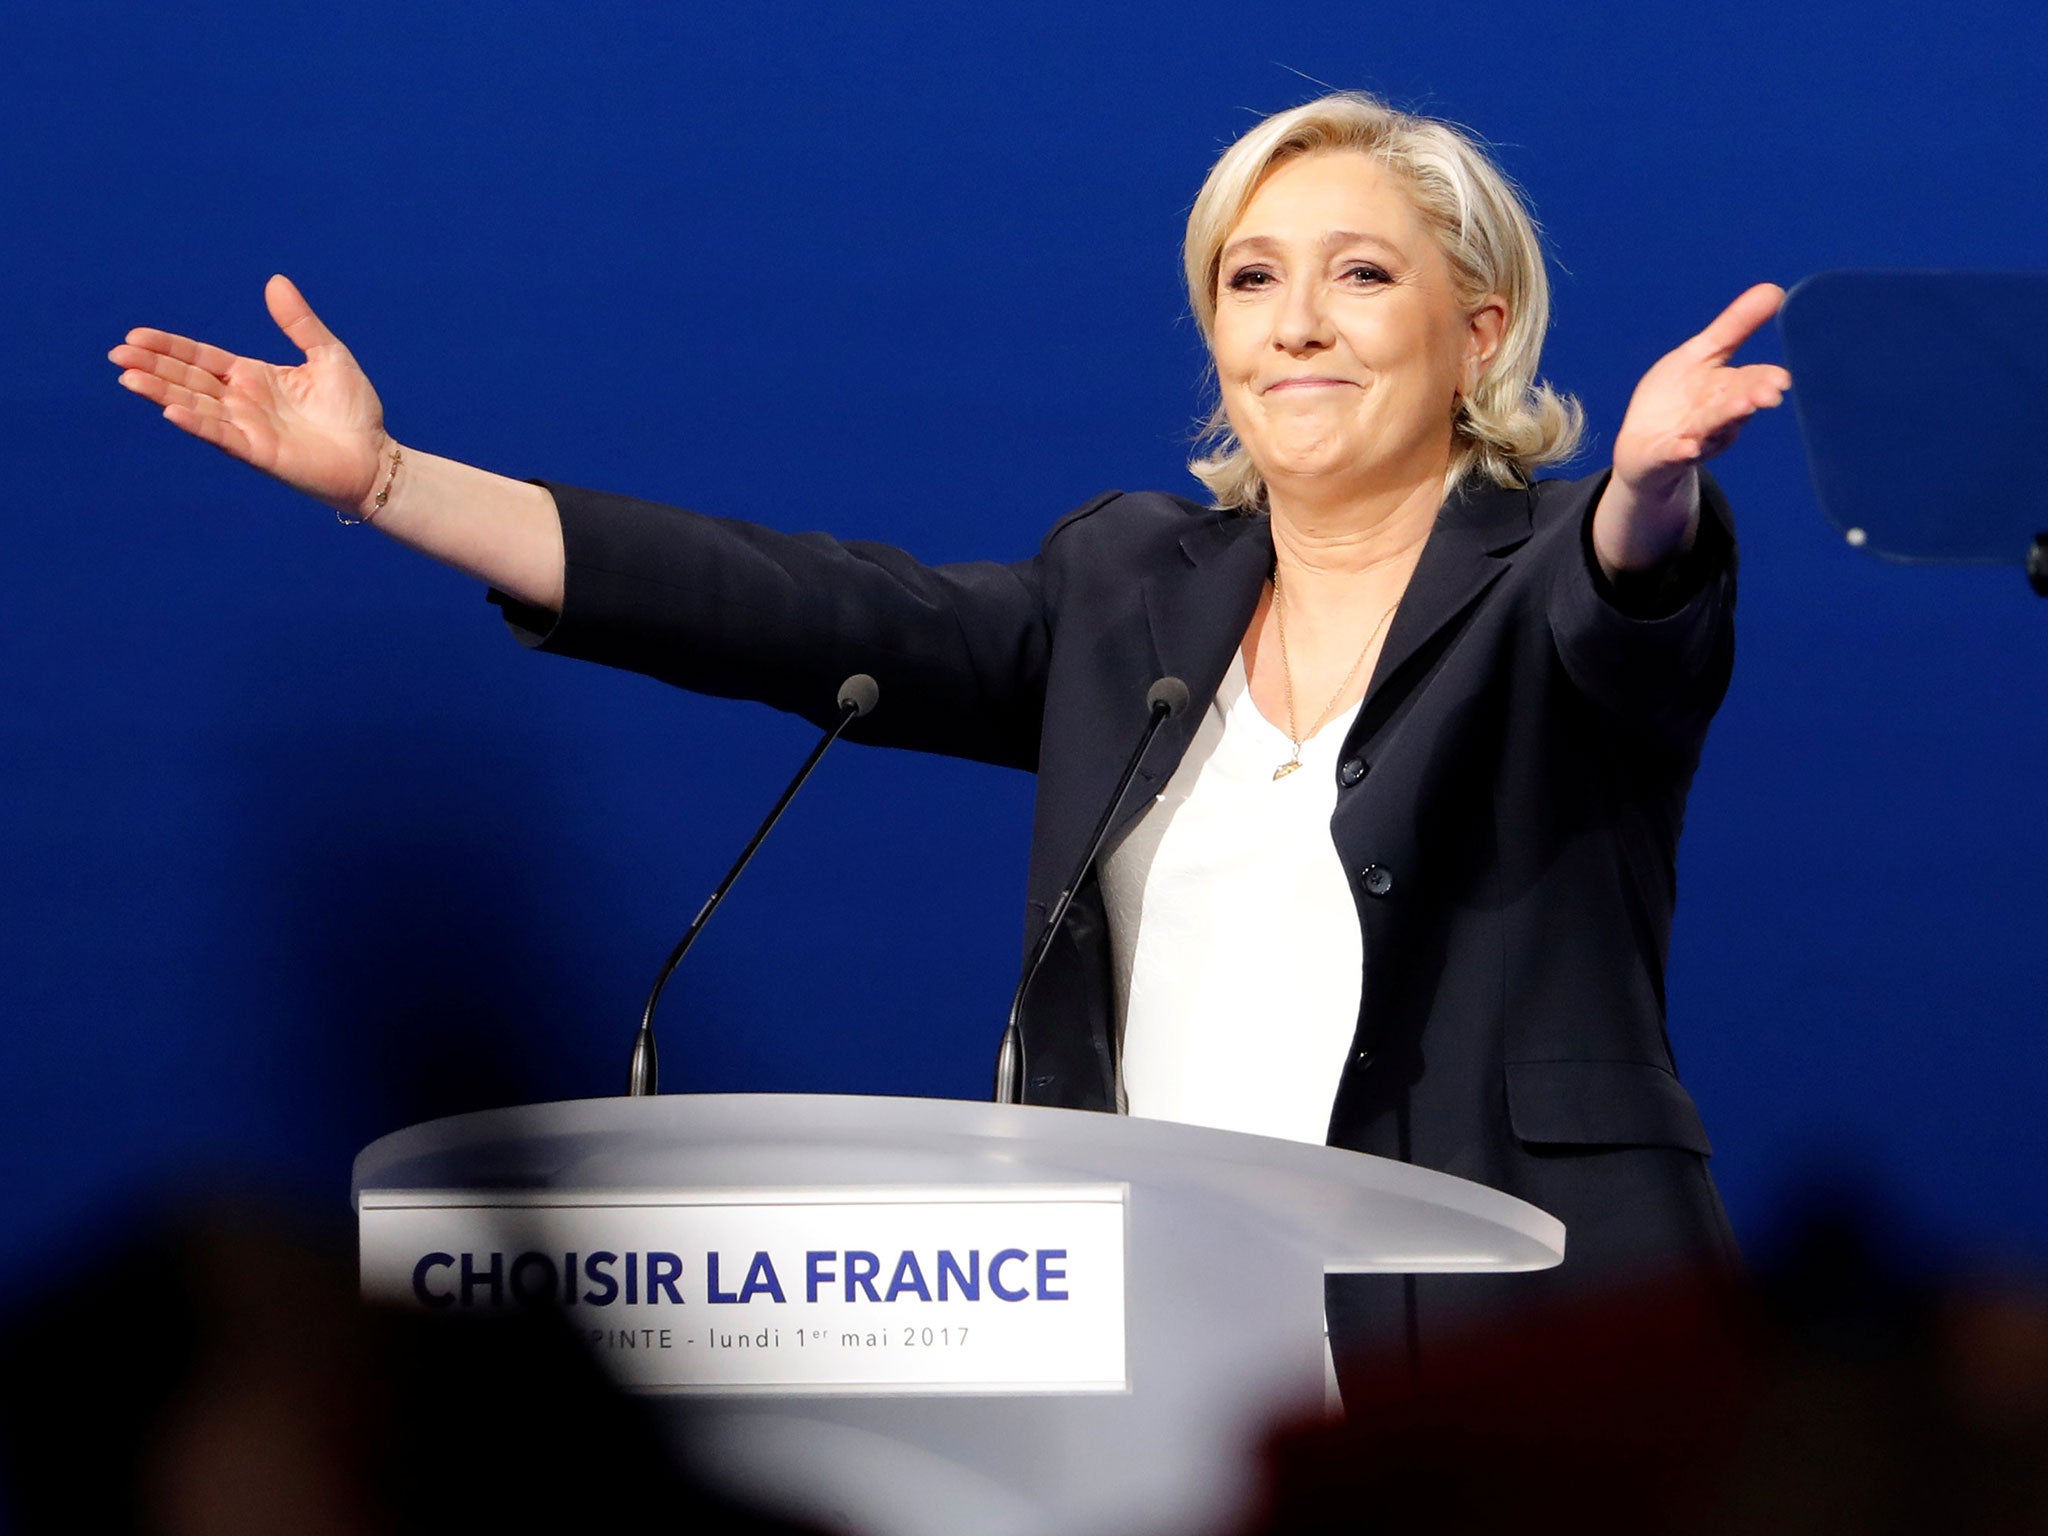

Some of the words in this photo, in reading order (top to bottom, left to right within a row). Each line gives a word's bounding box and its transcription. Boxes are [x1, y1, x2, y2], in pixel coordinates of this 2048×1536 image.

[412, 1251, 684, 1306] CHOISIR
[707, 1251, 787, 1305] LA
[806, 1249, 1069, 1303] FRANCE
[590, 1329, 673, 1348] PINTE
[709, 1327, 779, 1349] lundi
[796, 1328, 829, 1347] 1er
[840, 1327, 889, 1347] mai
[903, 1326, 971, 1347] 2017
